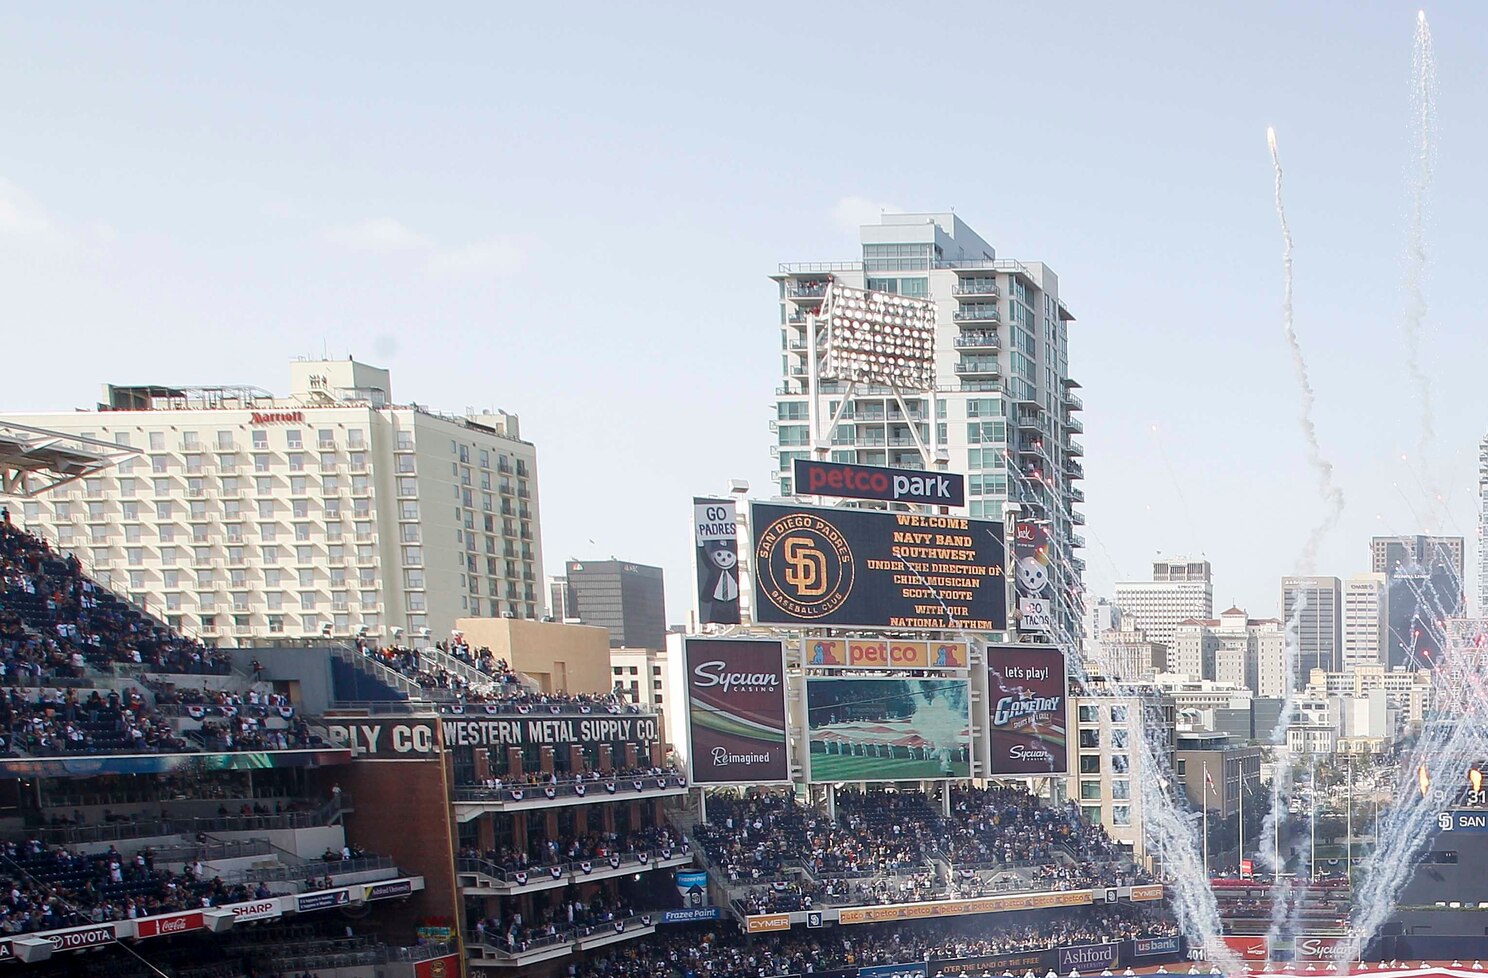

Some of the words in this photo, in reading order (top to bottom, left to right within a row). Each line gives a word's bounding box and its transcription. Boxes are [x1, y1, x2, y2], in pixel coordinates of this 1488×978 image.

[249, 411, 302, 424] Marriott
[809, 465, 888, 492] petco
[893, 475, 950, 498] park
[707, 507, 726, 521] GO
[896, 515, 968, 529] WELCOME
[700, 523, 736, 535] PADRES
[1017, 526, 1034, 540] Jack
[760, 533, 776, 558] SAN
[775, 517, 812, 534] DIEGO
[816, 522, 850, 563] PADRES
[894, 532, 932, 545] NAVY
[936, 535, 972, 547] BAND
[892, 547, 975, 561] SOUTHWEST
[868, 560, 905, 570] UNDER
[908, 562, 929, 572] THE
[931, 564, 986, 575] DIRECTION
[894, 575, 924, 585] CHIEF
[928, 578, 980, 587] MUSICIAN
[903, 589, 936, 598] SCOTT
[940, 591, 972, 600] FOOTE
[771, 590, 818, 614] BASEBALL
[821, 592, 842, 610] CLUB
[915, 605, 945, 614] WITH
[948, 607, 968, 616] OUR
[890, 618, 945, 627] NATIONAL
[949, 619, 992, 629] ANTHEM
[1024, 615, 1049, 625] TACOS
[850, 643, 917, 665] petco
[695, 661, 779, 692] Sycuan
[1005, 667, 1023, 678] let's
[1026, 667, 1049, 680] play!
[442, 722, 522, 745] WESTERN
[529, 720, 578, 743] METAL
[581, 720, 632, 742] SUPPLY
[637, 720, 658, 740] CO.
[712, 747, 769, 766] Reimagined
[1010, 745, 1049, 761] Sycuan
[1468, 790, 1486, 804] 31
[1460, 817, 1485, 827] SAN
[1064, 894, 1084, 903] petco
[1133, 890, 1162, 898] CYMER
[232, 903, 273, 917] SHARP
[666, 911, 693, 920] Frazee
[875, 910, 897, 919] petco
[908, 908, 931, 916] petco
[941, 905, 963, 914] petco
[749, 920, 788, 928] CYMER
[64, 929, 110, 946] TOYOTA
[1064, 947, 1112, 964] Ashford
[1187, 950, 1203, 960] 401
[944, 965, 961, 973] O'ER
[977, 962, 996, 970] LAND
